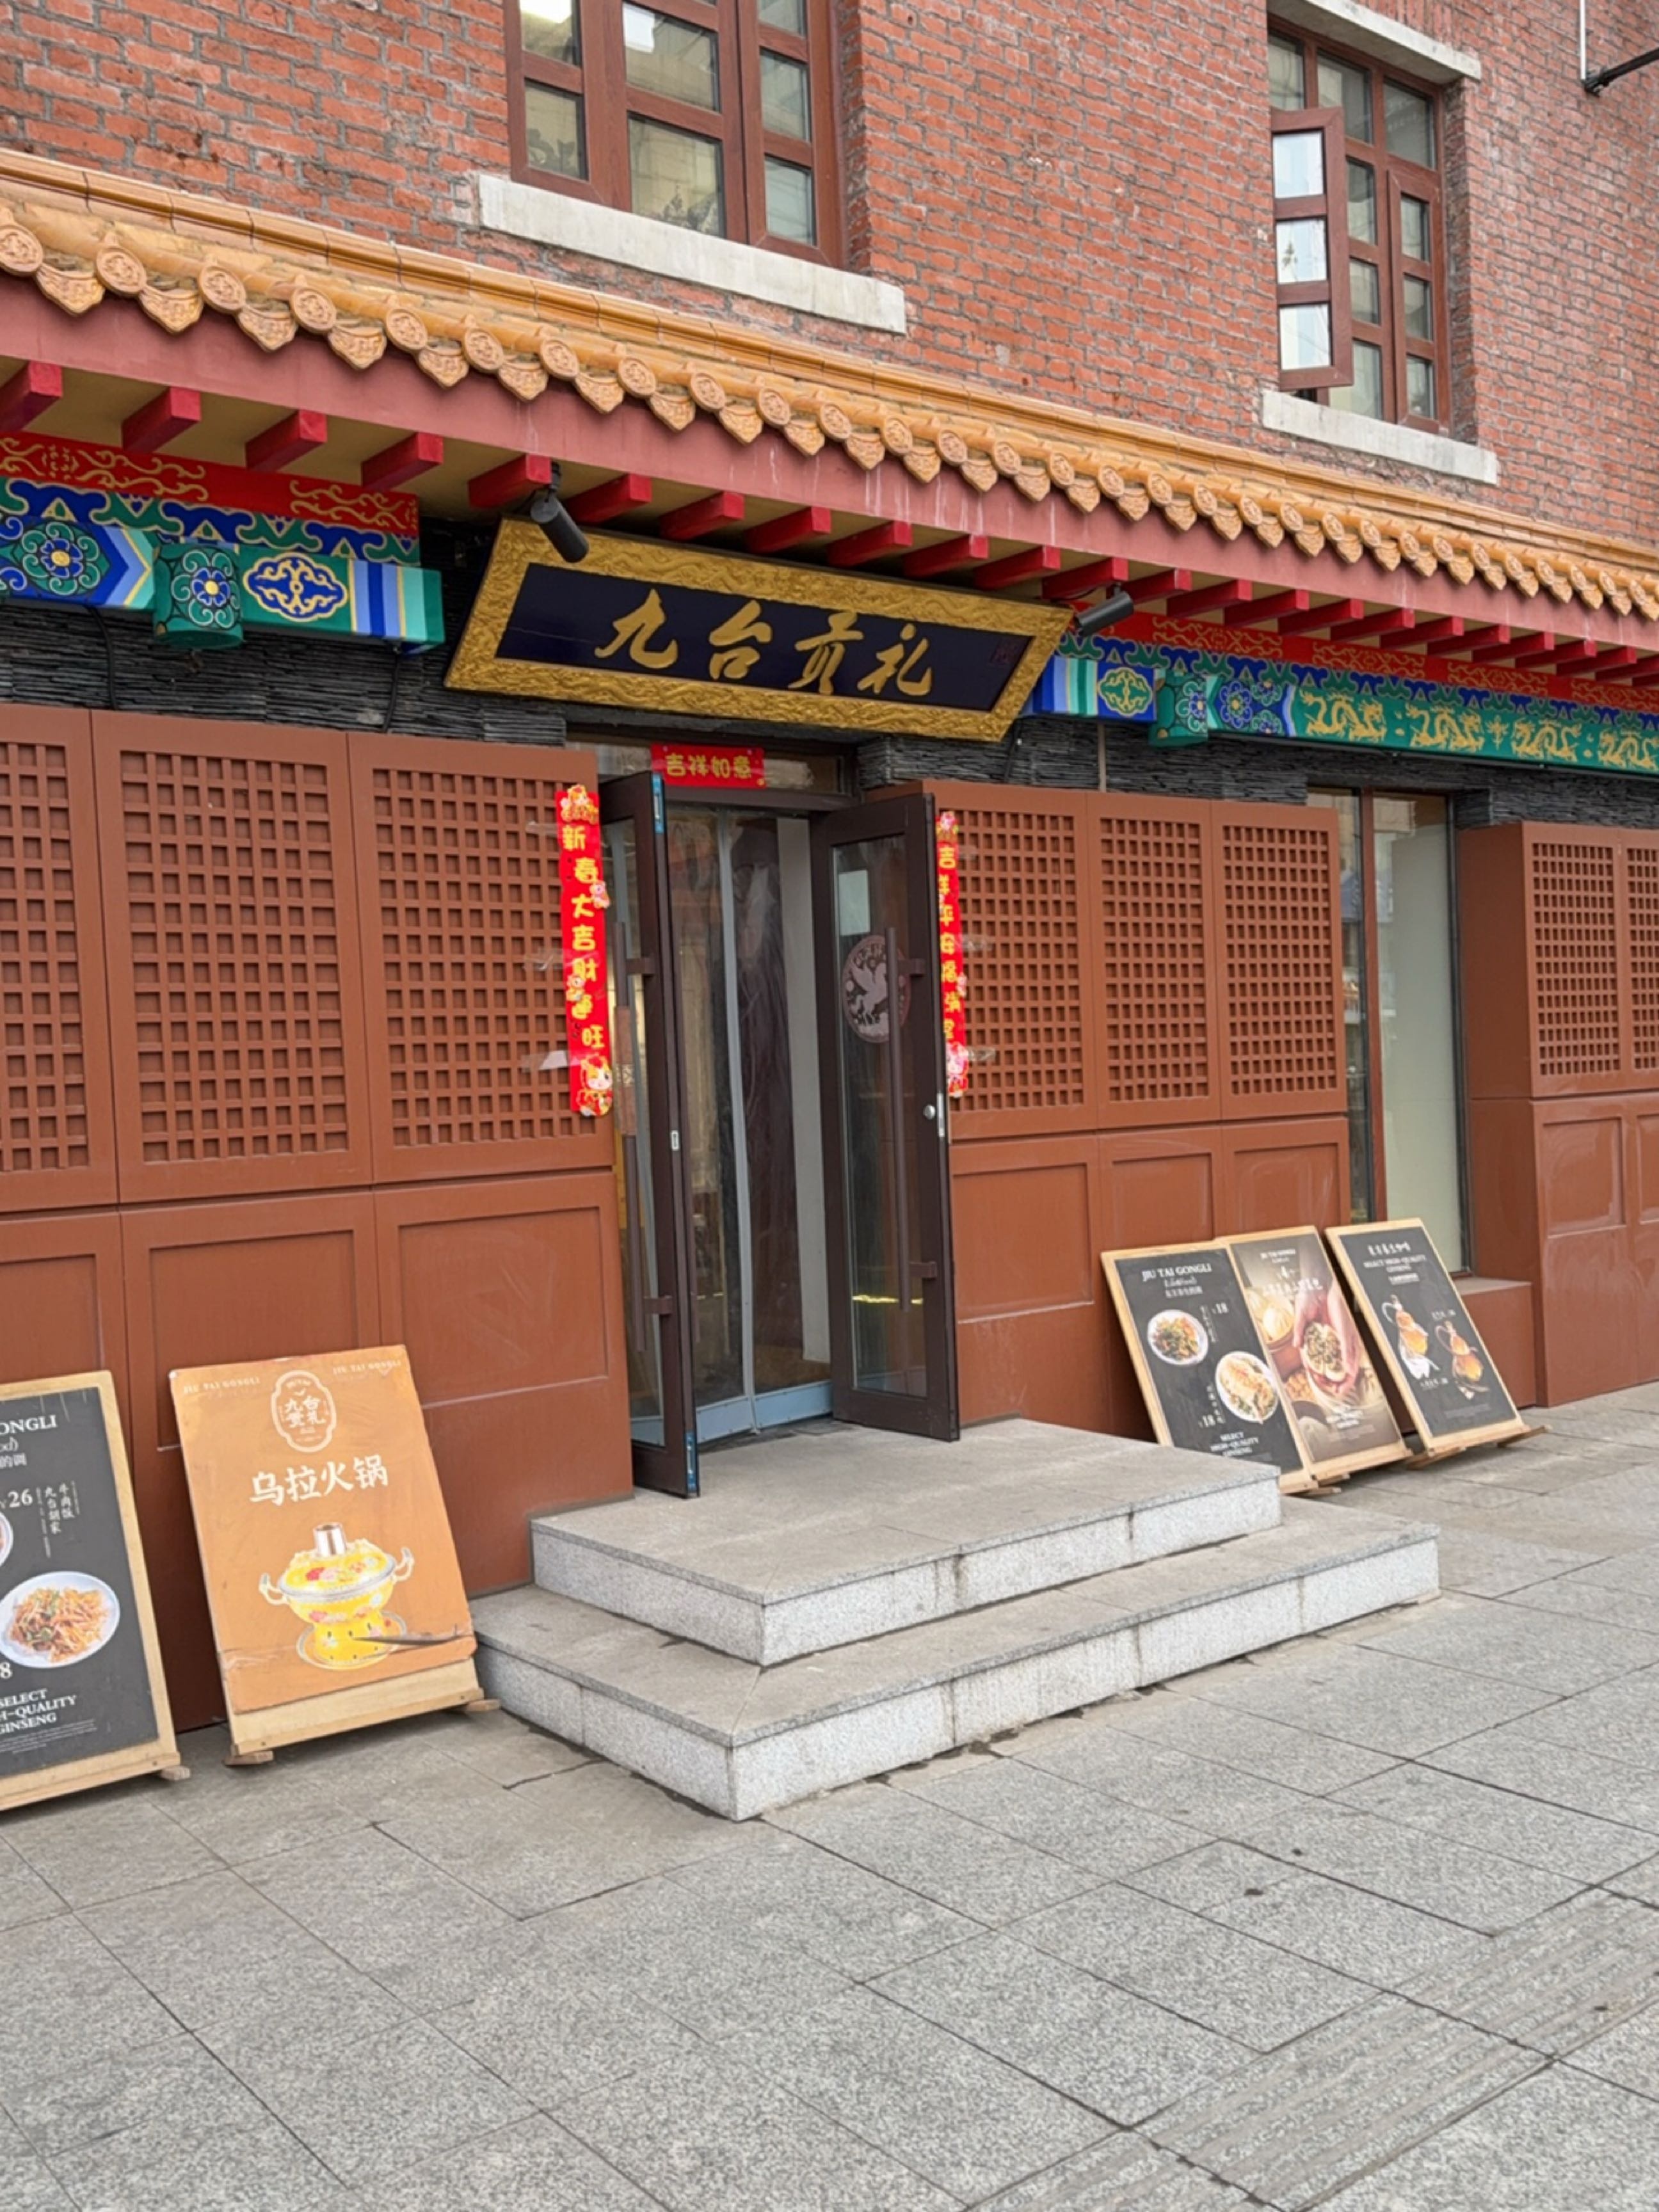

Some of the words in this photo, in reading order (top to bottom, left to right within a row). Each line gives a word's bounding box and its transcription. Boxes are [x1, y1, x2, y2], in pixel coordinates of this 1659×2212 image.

[594, 588, 932, 696] 九台贡礼
[664, 752, 752, 779] 吉祥如意
[249, 1454, 389, 1506] 乌拉火锅
